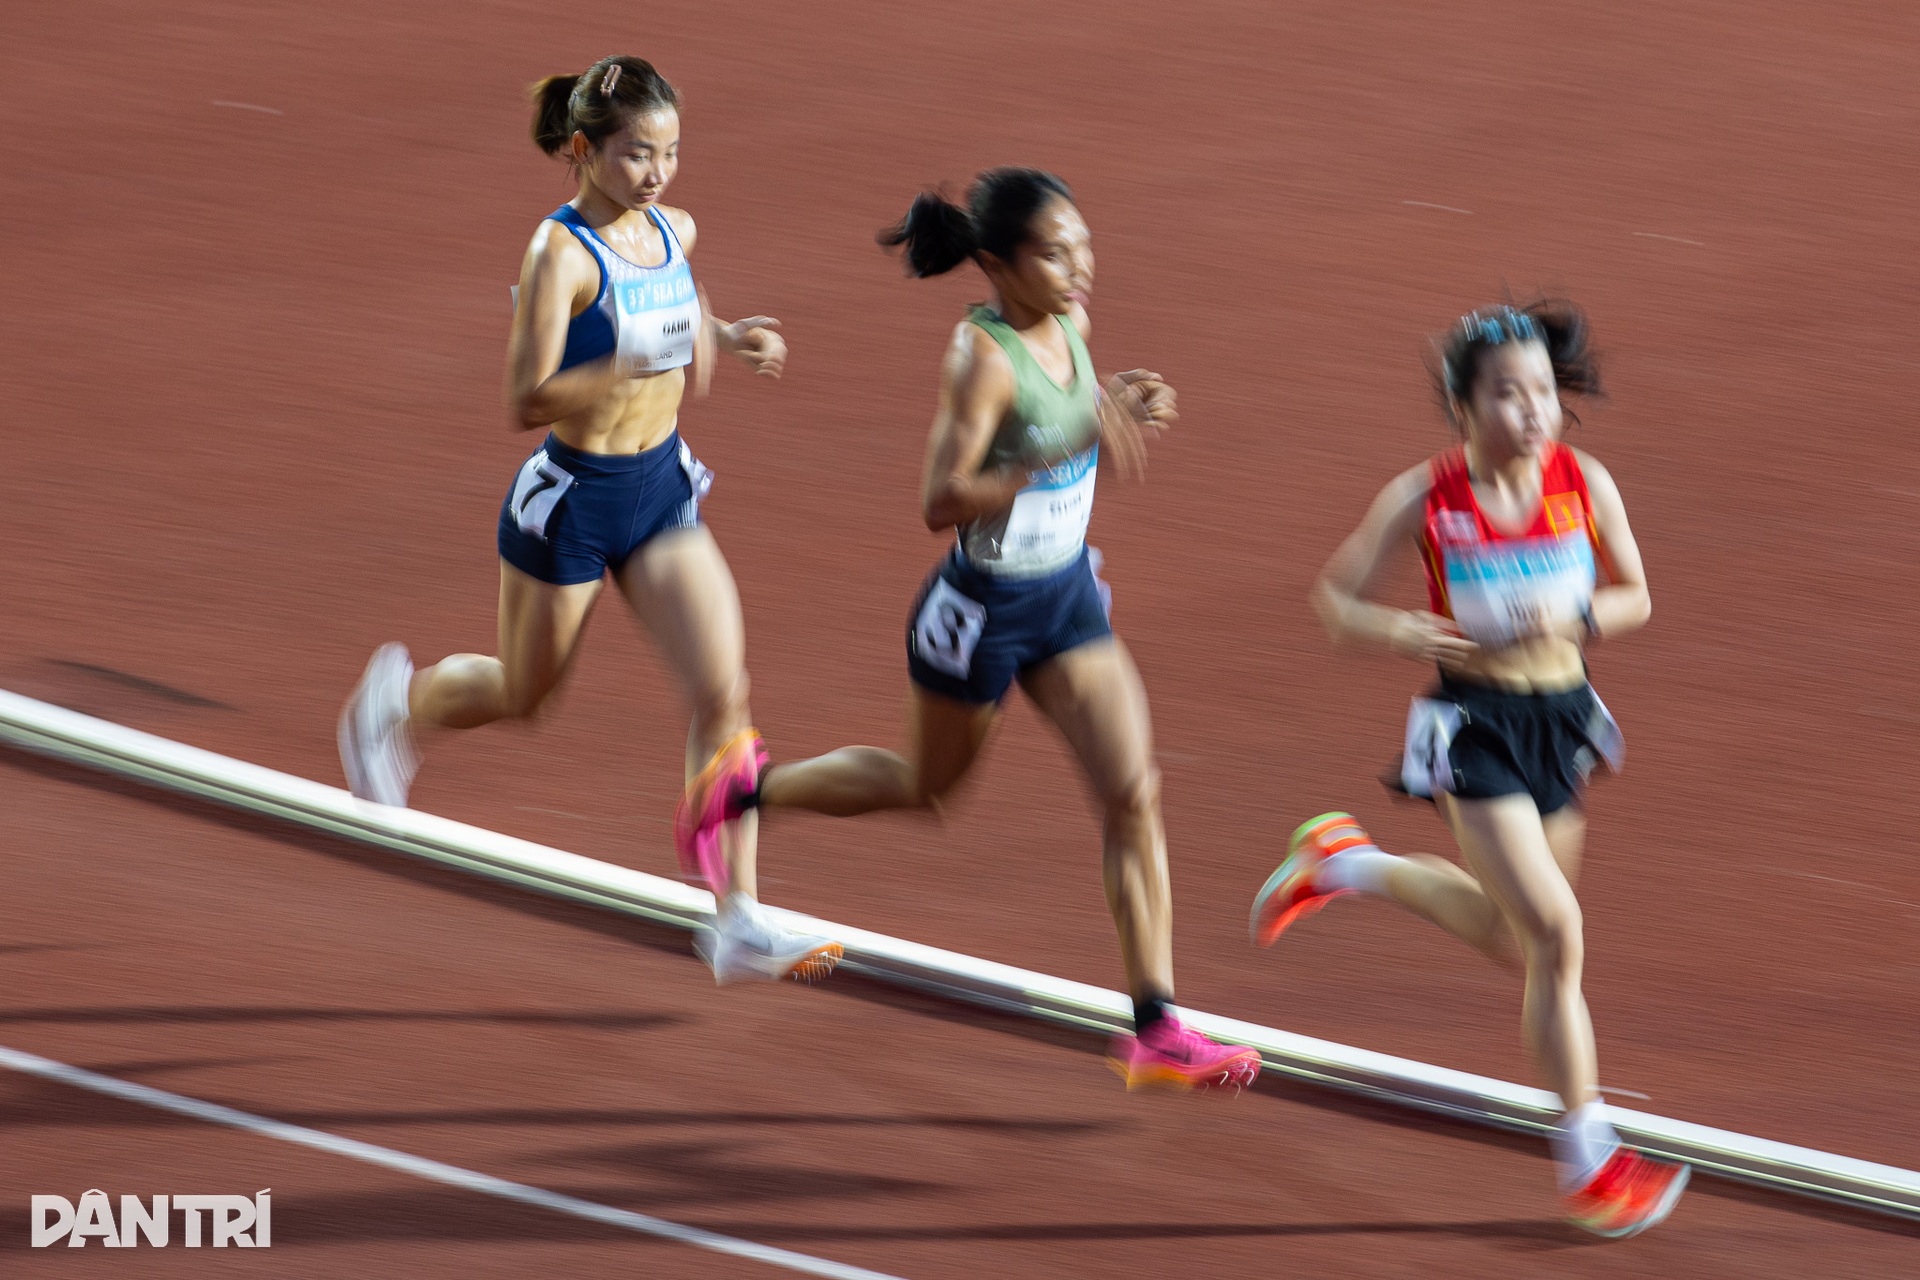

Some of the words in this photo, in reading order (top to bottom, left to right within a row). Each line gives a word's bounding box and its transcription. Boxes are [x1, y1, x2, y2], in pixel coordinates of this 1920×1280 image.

[653, 280, 674, 307] SEA
[662, 317, 690, 338] OANH
[519, 466, 560, 513] 7
